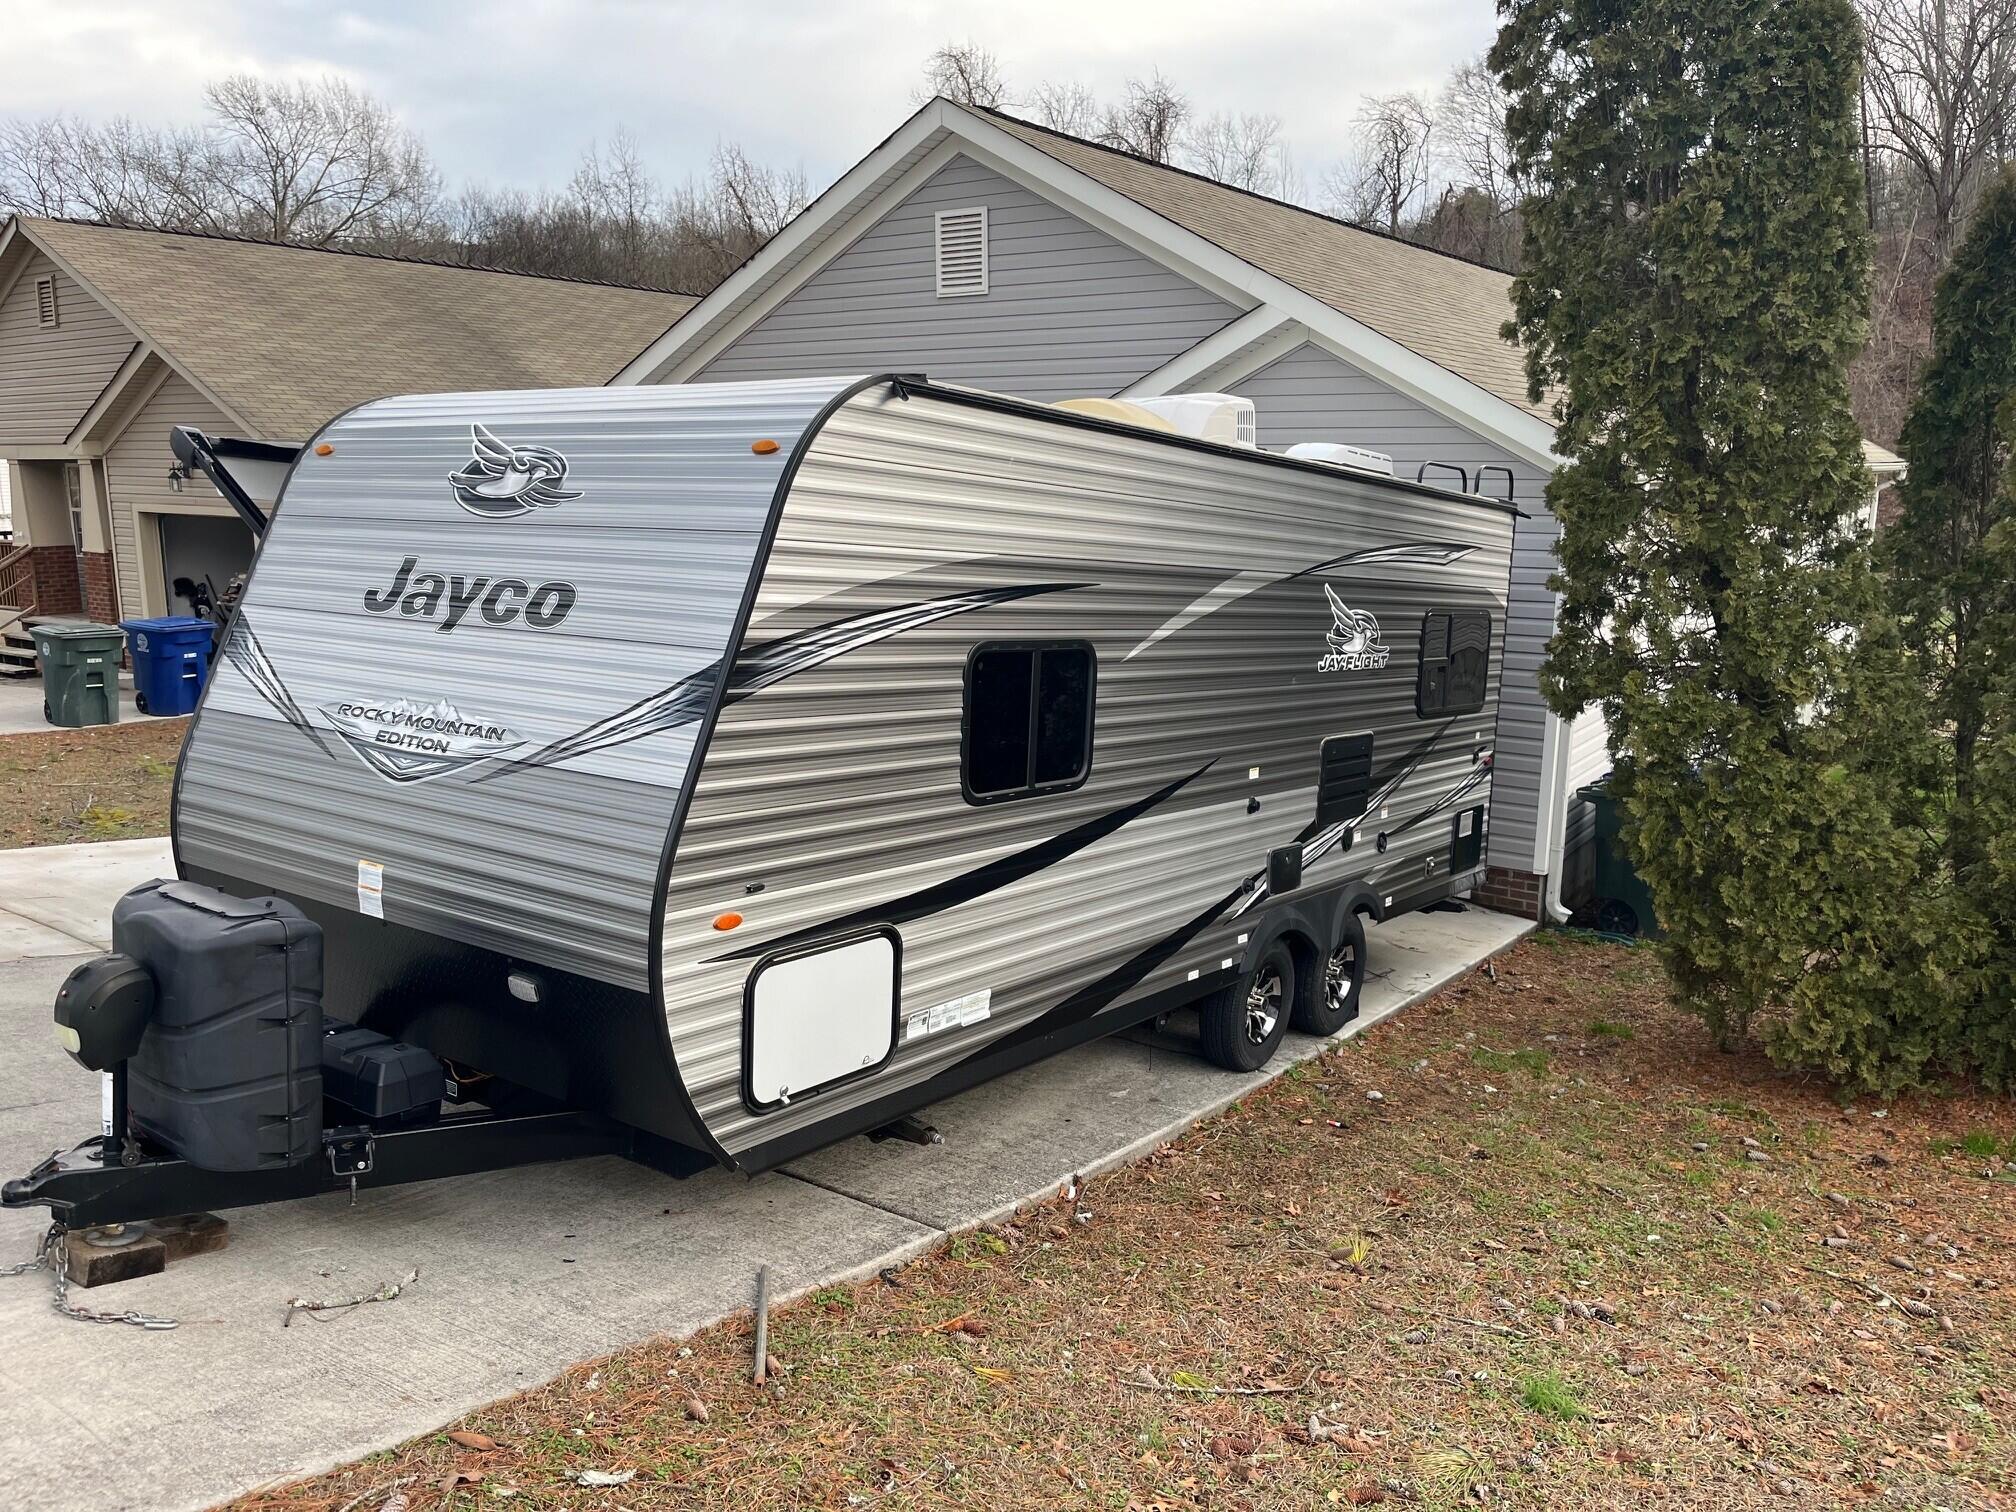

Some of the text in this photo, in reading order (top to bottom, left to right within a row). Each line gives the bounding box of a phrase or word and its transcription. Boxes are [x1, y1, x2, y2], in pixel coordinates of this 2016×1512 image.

[363, 554, 579, 634] Jayco
[337, 702, 507, 742] ROCKY MOUNTAIN
[374, 729, 451, 754] EDITION
